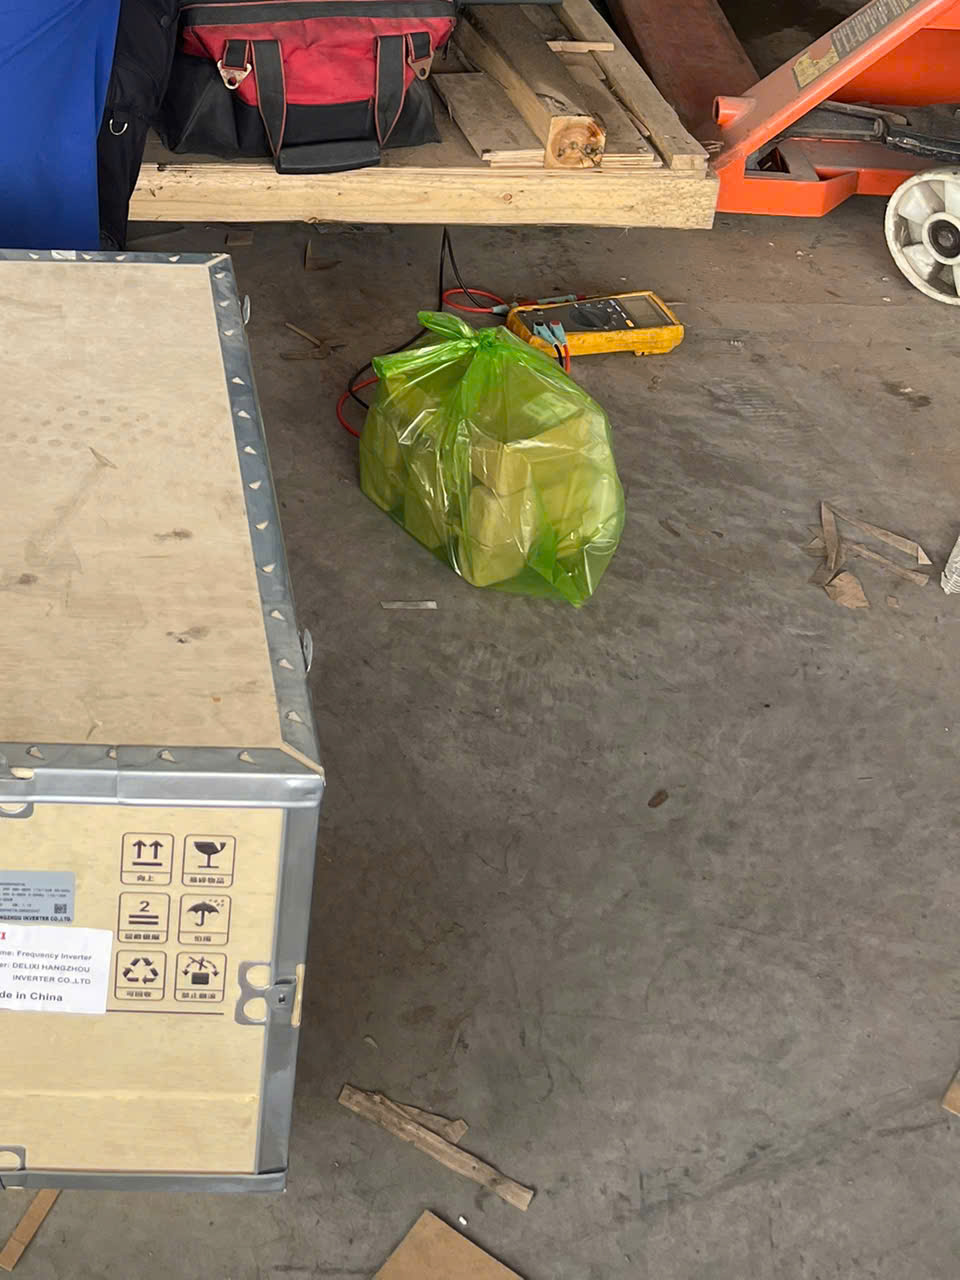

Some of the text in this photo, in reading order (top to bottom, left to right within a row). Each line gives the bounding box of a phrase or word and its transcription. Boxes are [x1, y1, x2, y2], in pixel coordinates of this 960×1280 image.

[139, 900, 150, 912] 2
[16, 950, 59, 960] Frequency
[61, 953, 92, 961] Inverter
[12, 962, 40, 970] DELIXI
[41, 964, 90, 973] HANGZHOU
[12, 974, 55, 983] INVERTER
[16, 991, 27, 1000] in
[30, 992, 63, 1002] China
